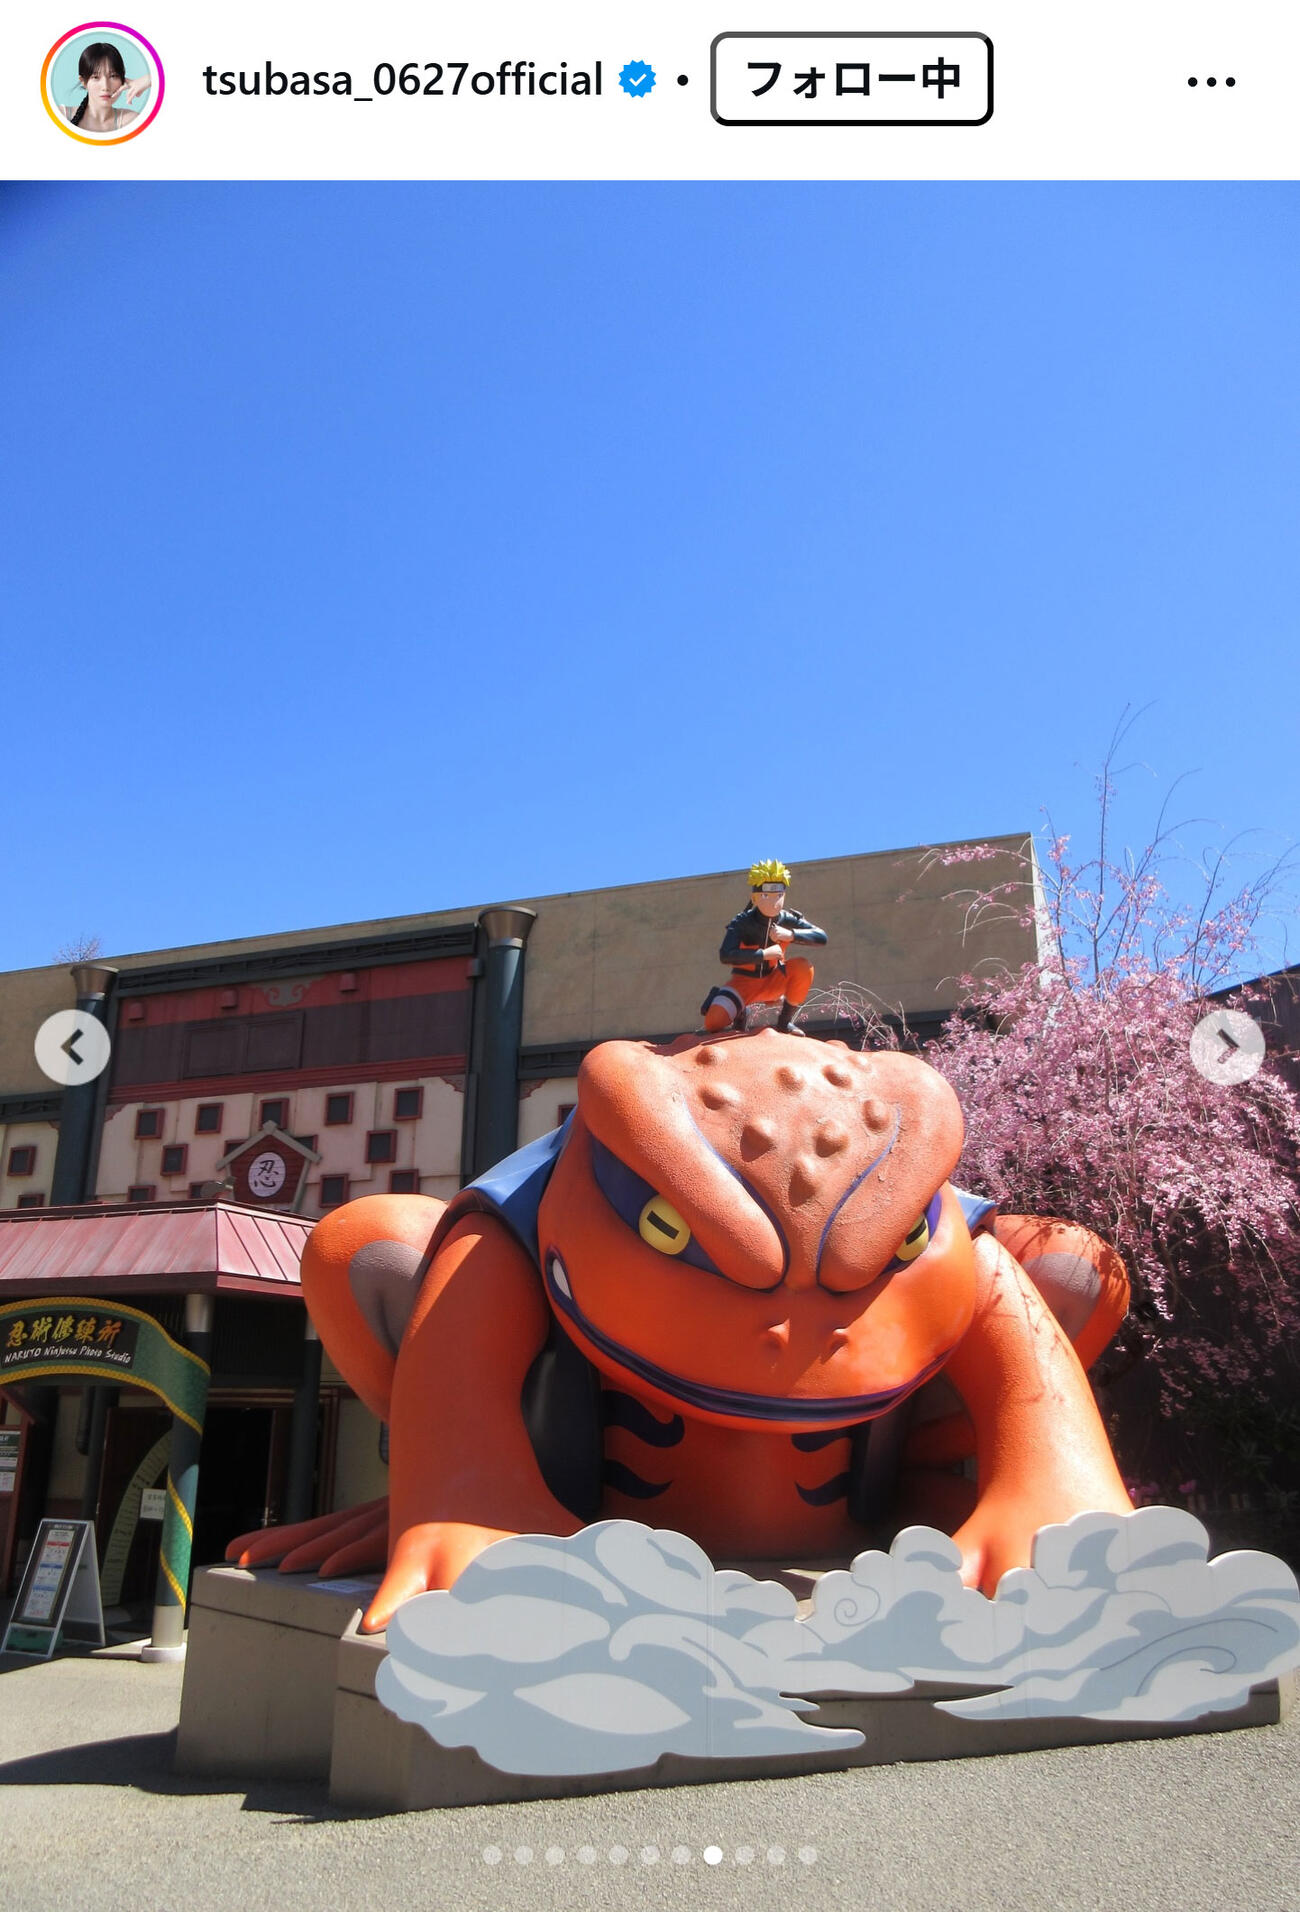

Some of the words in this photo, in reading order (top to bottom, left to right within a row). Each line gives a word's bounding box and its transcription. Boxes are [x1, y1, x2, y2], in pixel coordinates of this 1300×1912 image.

[254, 1160, 279, 1187] 忍
[4, 1347, 41, 1363] NARUTO
[44, 1345, 77, 1357] Ninjutsu
[80, 1345, 102, 1357] Photo
[105, 1349, 131, 1363] Studio
